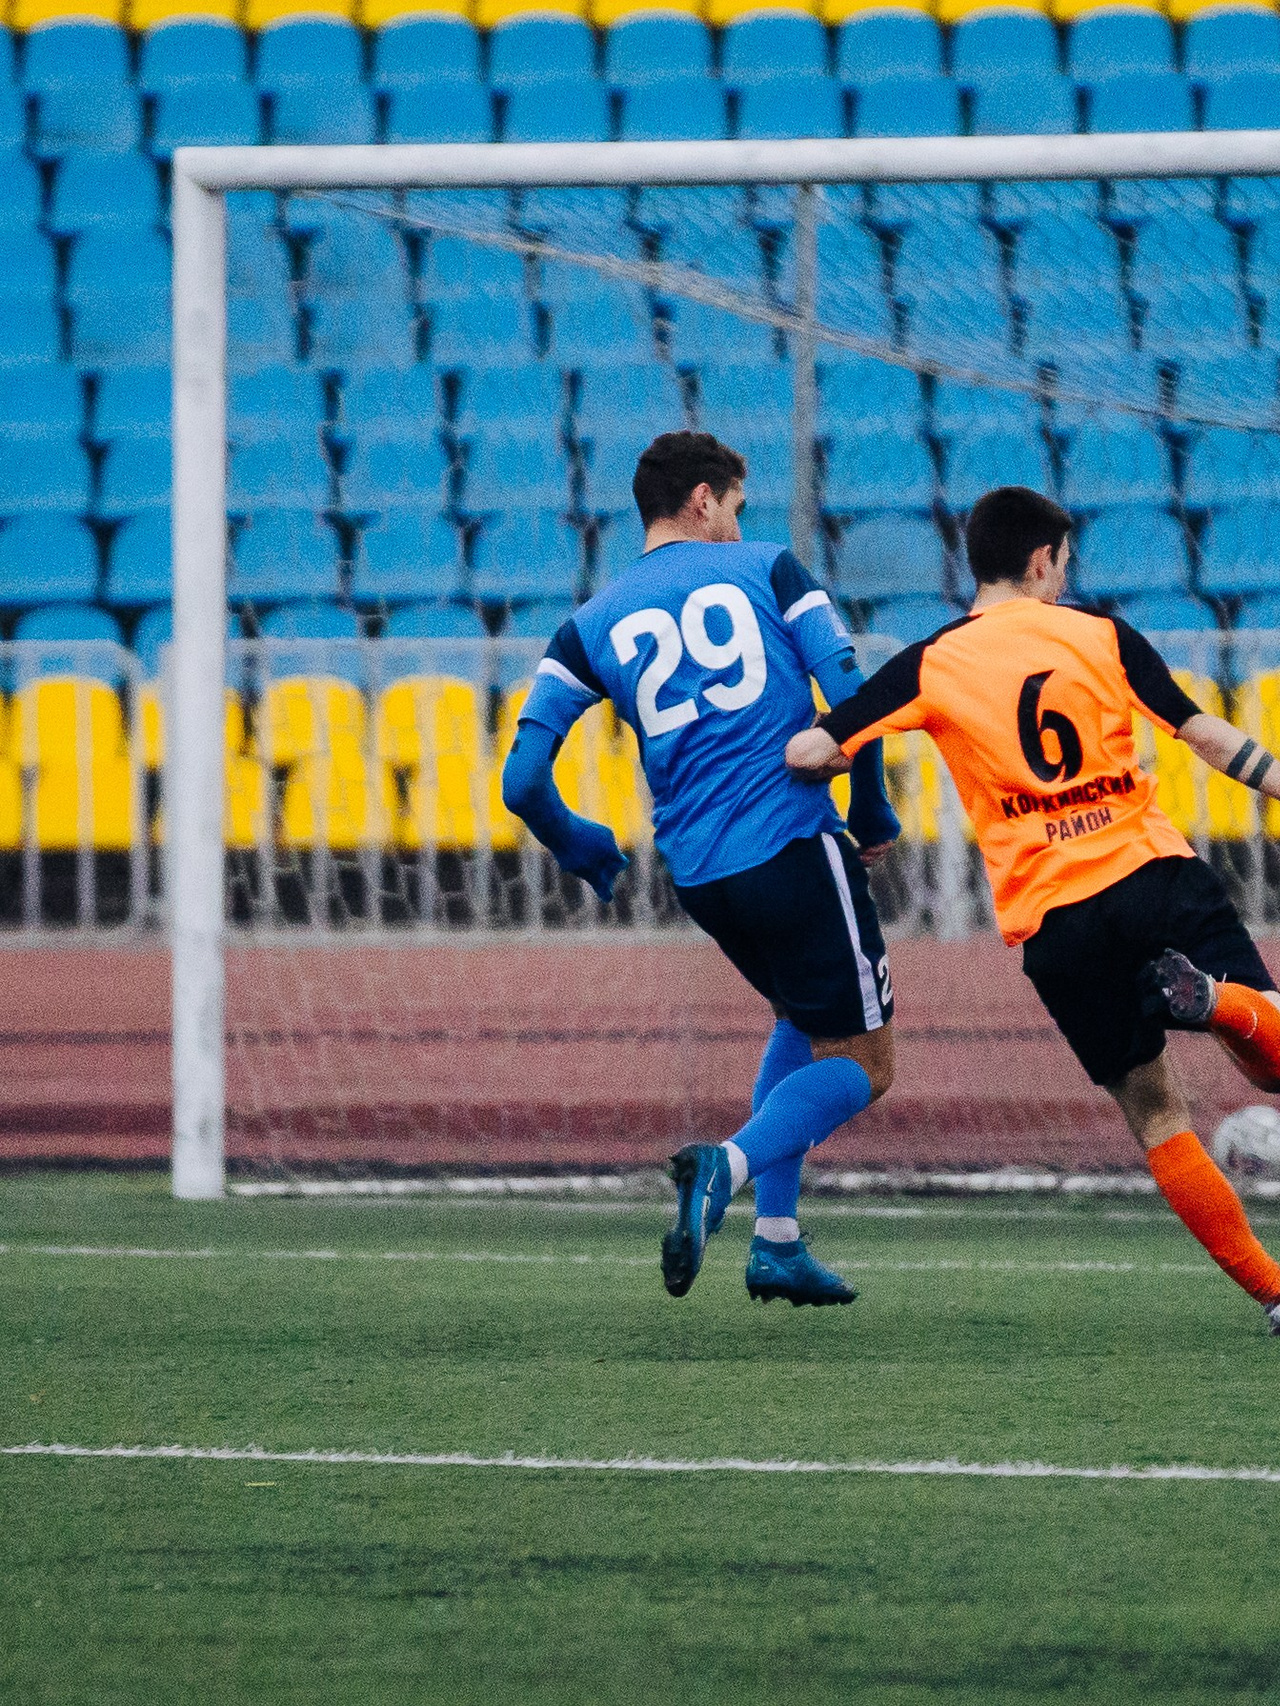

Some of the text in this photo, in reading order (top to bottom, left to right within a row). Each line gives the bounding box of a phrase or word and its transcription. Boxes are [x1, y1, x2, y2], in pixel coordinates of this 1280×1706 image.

[610, 583, 767, 737] 29
[1017, 669, 1083, 783] 6
[1045, 807, 1112, 842] РАЙОН
